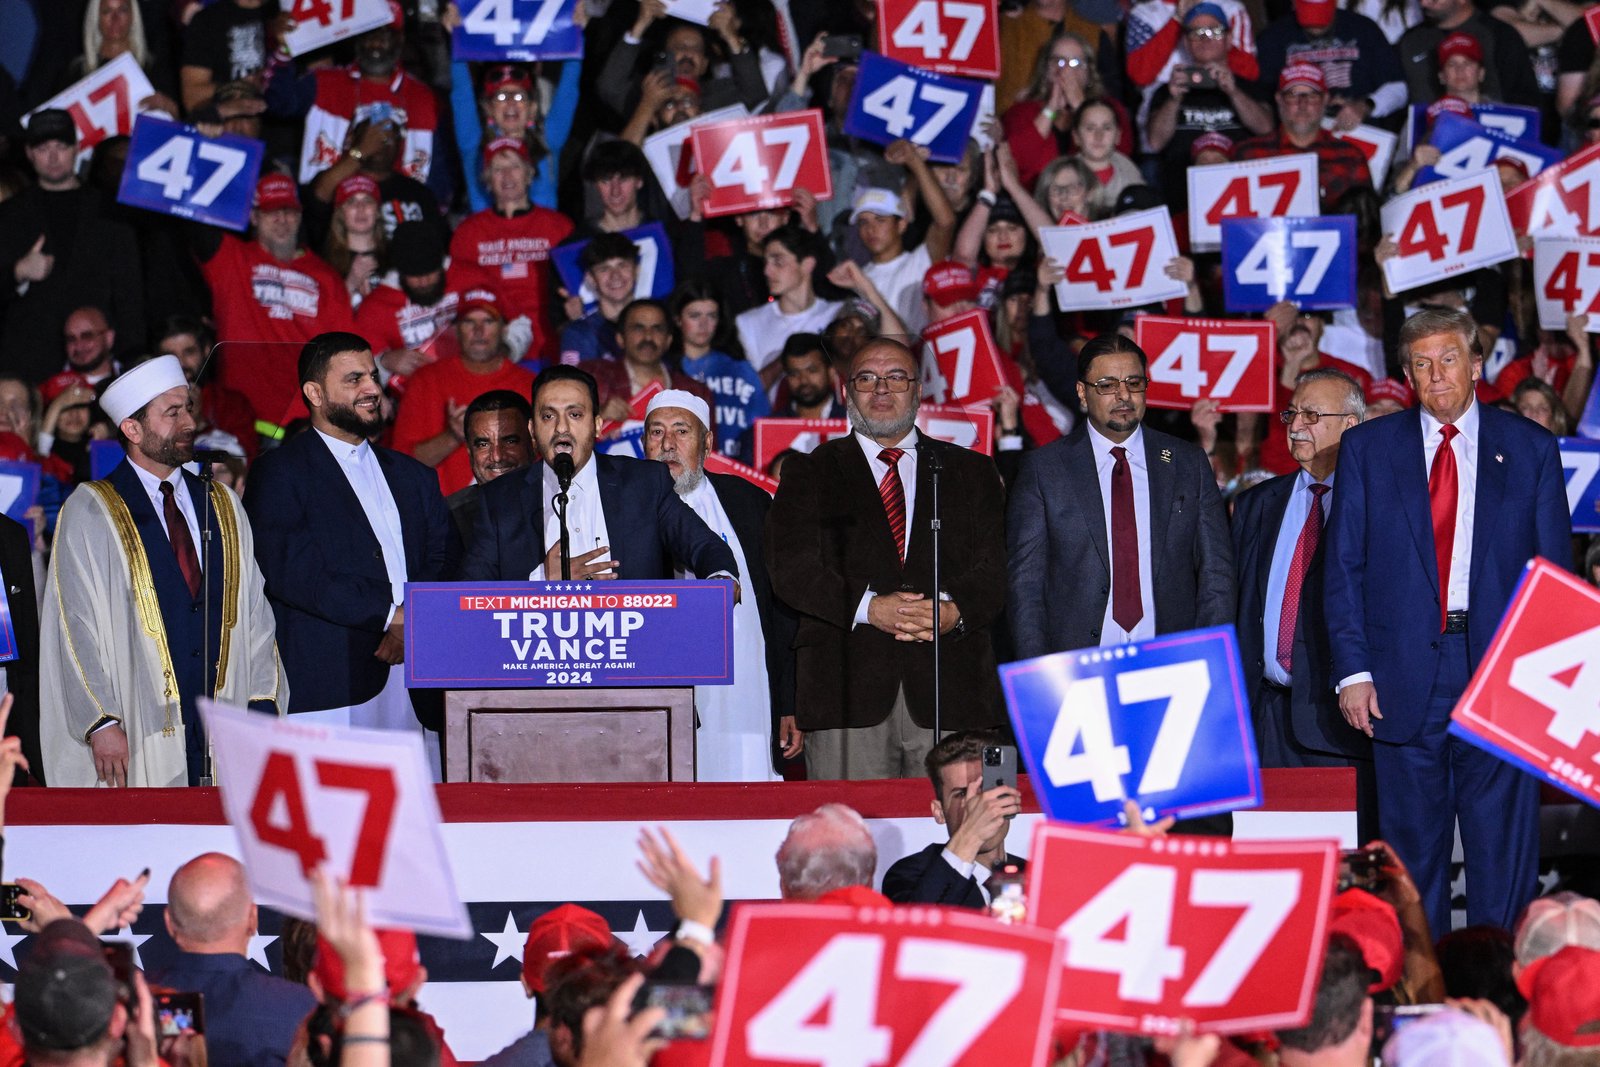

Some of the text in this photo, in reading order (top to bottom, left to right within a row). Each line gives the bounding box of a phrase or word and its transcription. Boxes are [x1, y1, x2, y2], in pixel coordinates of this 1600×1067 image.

[464, 0, 570, 46] 47
[892, 1, 987, 60] 47
[862, 75, 969, 146] 47
[137, 134, 247, 208] 47
[710, 124, 811, 195] 47
[1205, 170, 1301, 225] 47
[1398, 185, 1485, 263] 47
[1065, 226, 1156, 294] 47
[1234, 230, 1341, 296] 47
[1149, 332, 1260, 399] 47
[1558, 450, 1600, 518] 7
[465, 595, 673, 610] TEXT MICHIGAN TO 88022
[493, 611, 645, 638] TRUMP
[510, 638, 627, 661] VANCE
[546, 671, 593, 684] 2024
[1507, 625, 1600, 754] 4
[1042, 659, 1212, 803] 47
[249, 751, 399, 887] 47
[1057, 862, 1304, 1008] 47
[745, 932, 1027, 1067] 47
